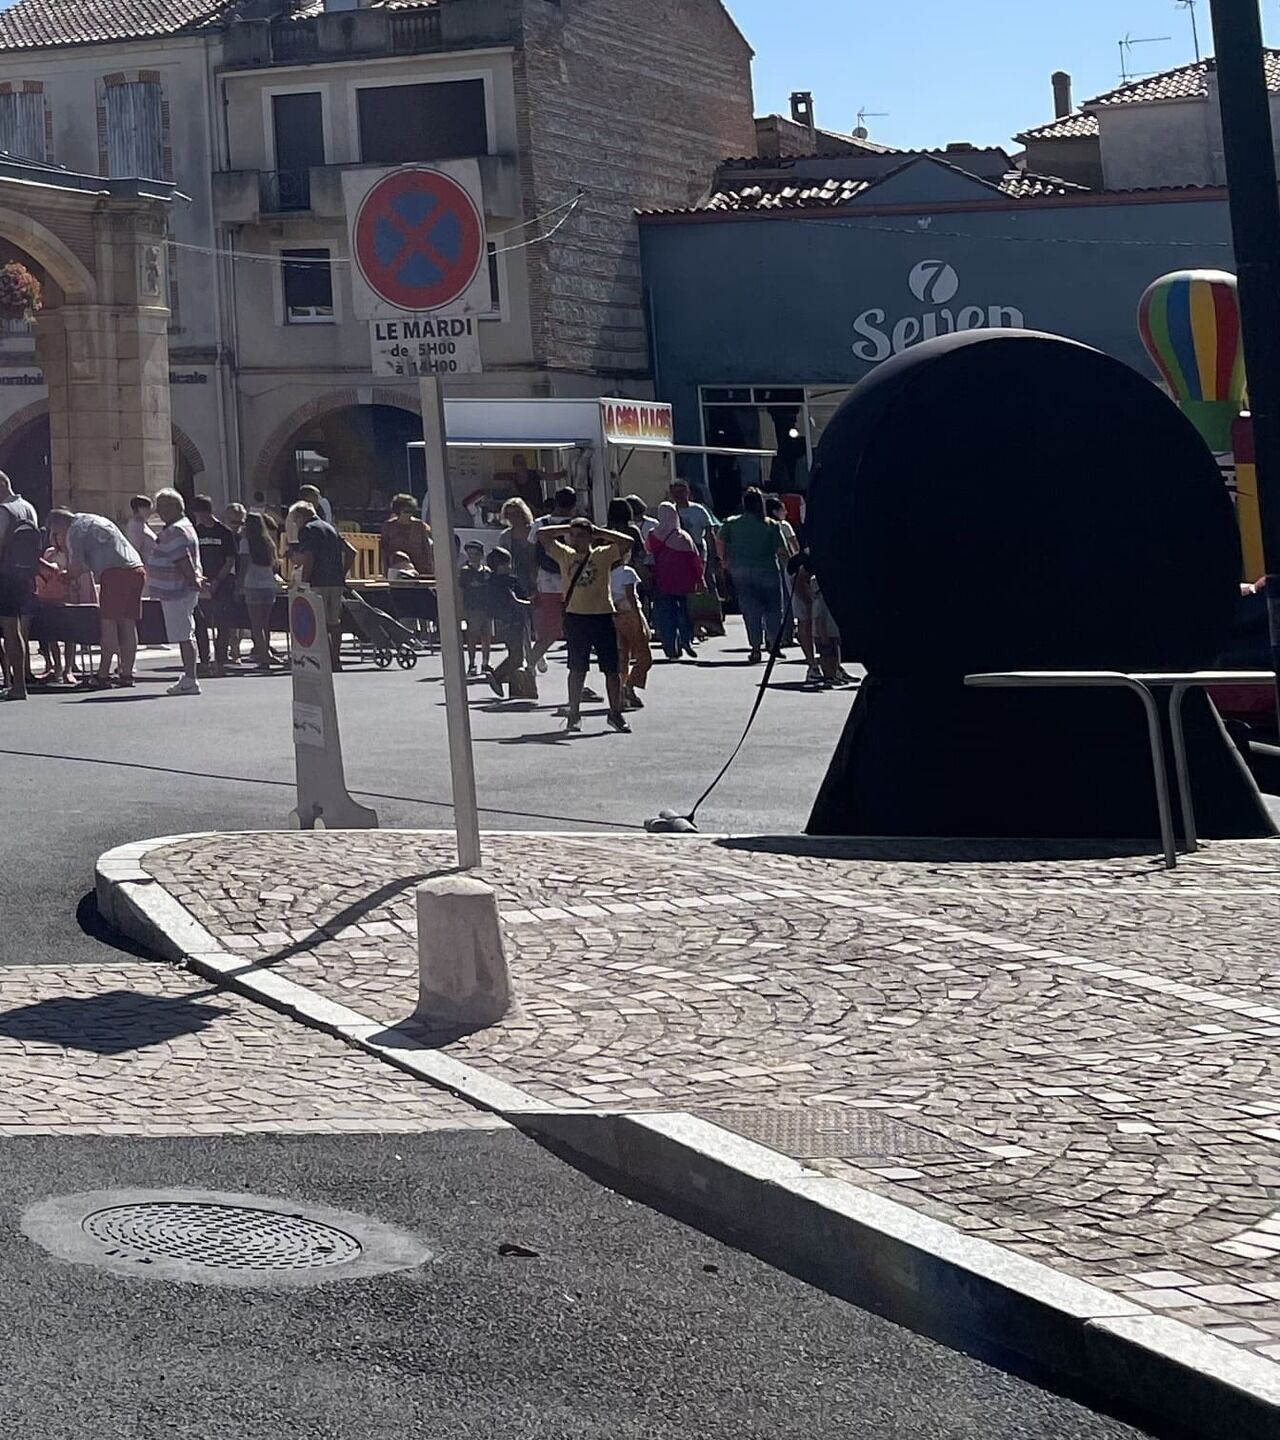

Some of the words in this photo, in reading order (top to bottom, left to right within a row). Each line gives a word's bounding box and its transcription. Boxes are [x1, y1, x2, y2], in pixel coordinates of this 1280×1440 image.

[376, 323, 398, 341] LE
[404, 318, 472, 339] MARDI
[851, 305, 1024, 362] Seven
[391, 344, 409, 357] de
[418, 342, 456, 356] 5H00
[395, 361, 403, 374] à
